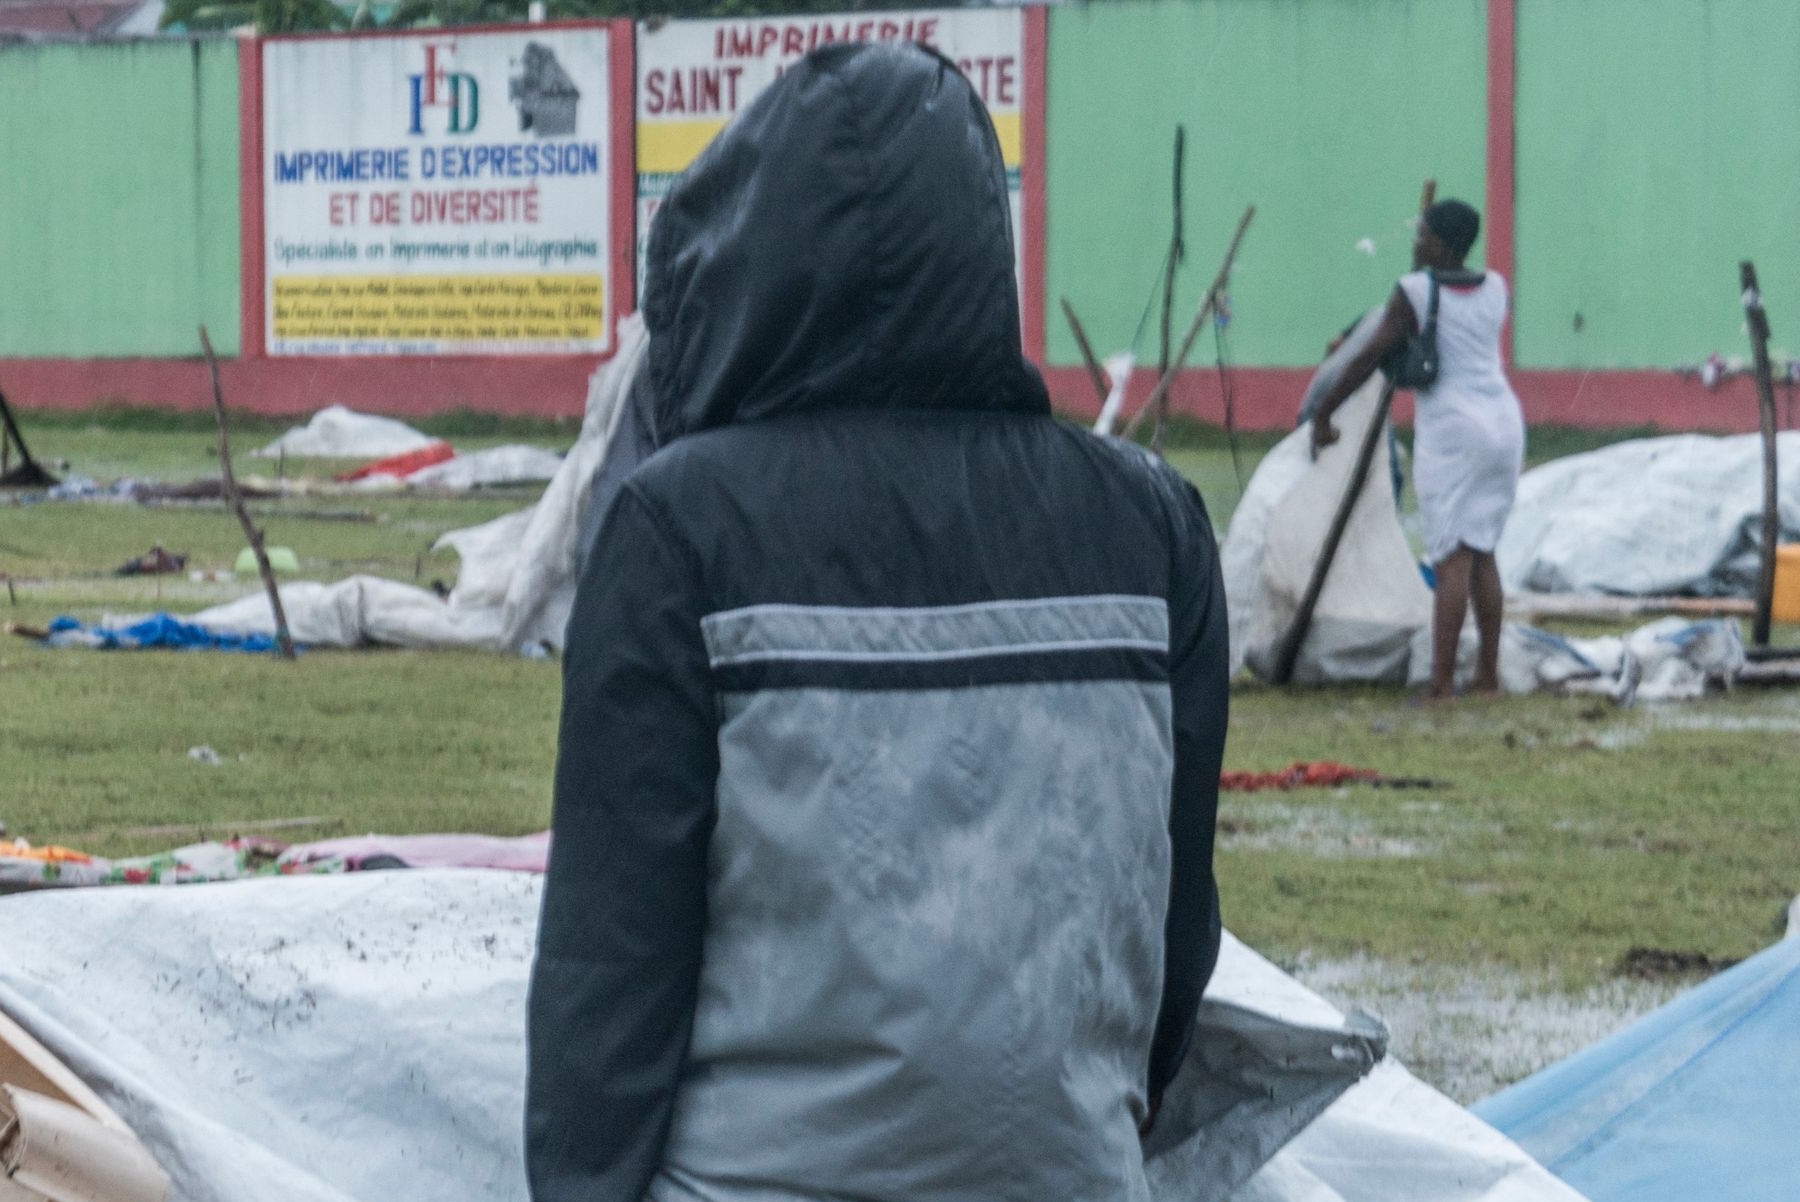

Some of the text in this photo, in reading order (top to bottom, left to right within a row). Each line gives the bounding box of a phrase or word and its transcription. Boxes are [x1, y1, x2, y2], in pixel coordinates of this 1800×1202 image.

[646, 66, 743, 114] SAINT
[274, 149, 409, 184] IMPRIMERIE
[329, 178, 539, 226] ET DE DIVERSITÉ
